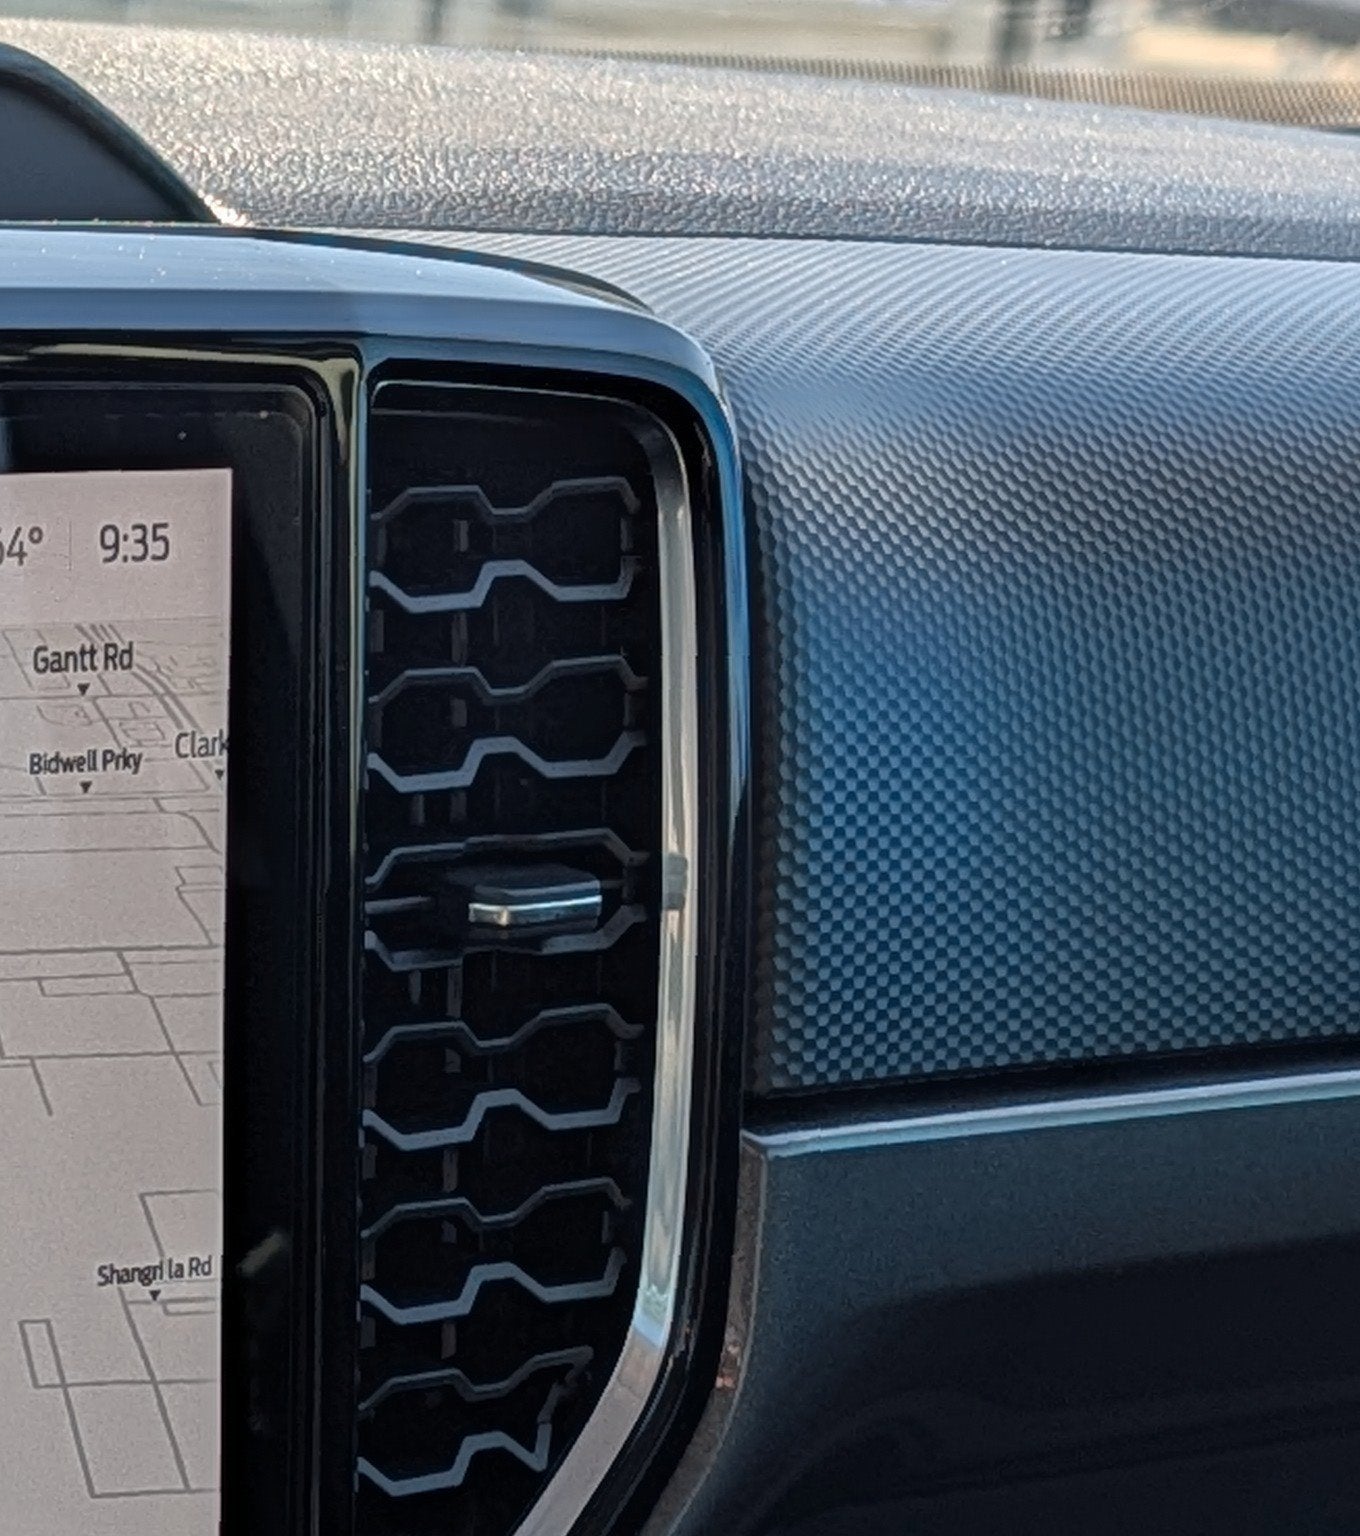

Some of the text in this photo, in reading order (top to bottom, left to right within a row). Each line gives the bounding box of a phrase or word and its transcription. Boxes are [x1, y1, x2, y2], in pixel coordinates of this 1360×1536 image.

[99, 522, 171, 564] 9:35
[32, 641, 134, 675] Gantt Rd
[28, 752, 97, 776] Bidwell
[97, 1259, 164, 1287] Shangri
[189, 1254, 212, 1277] Rd
